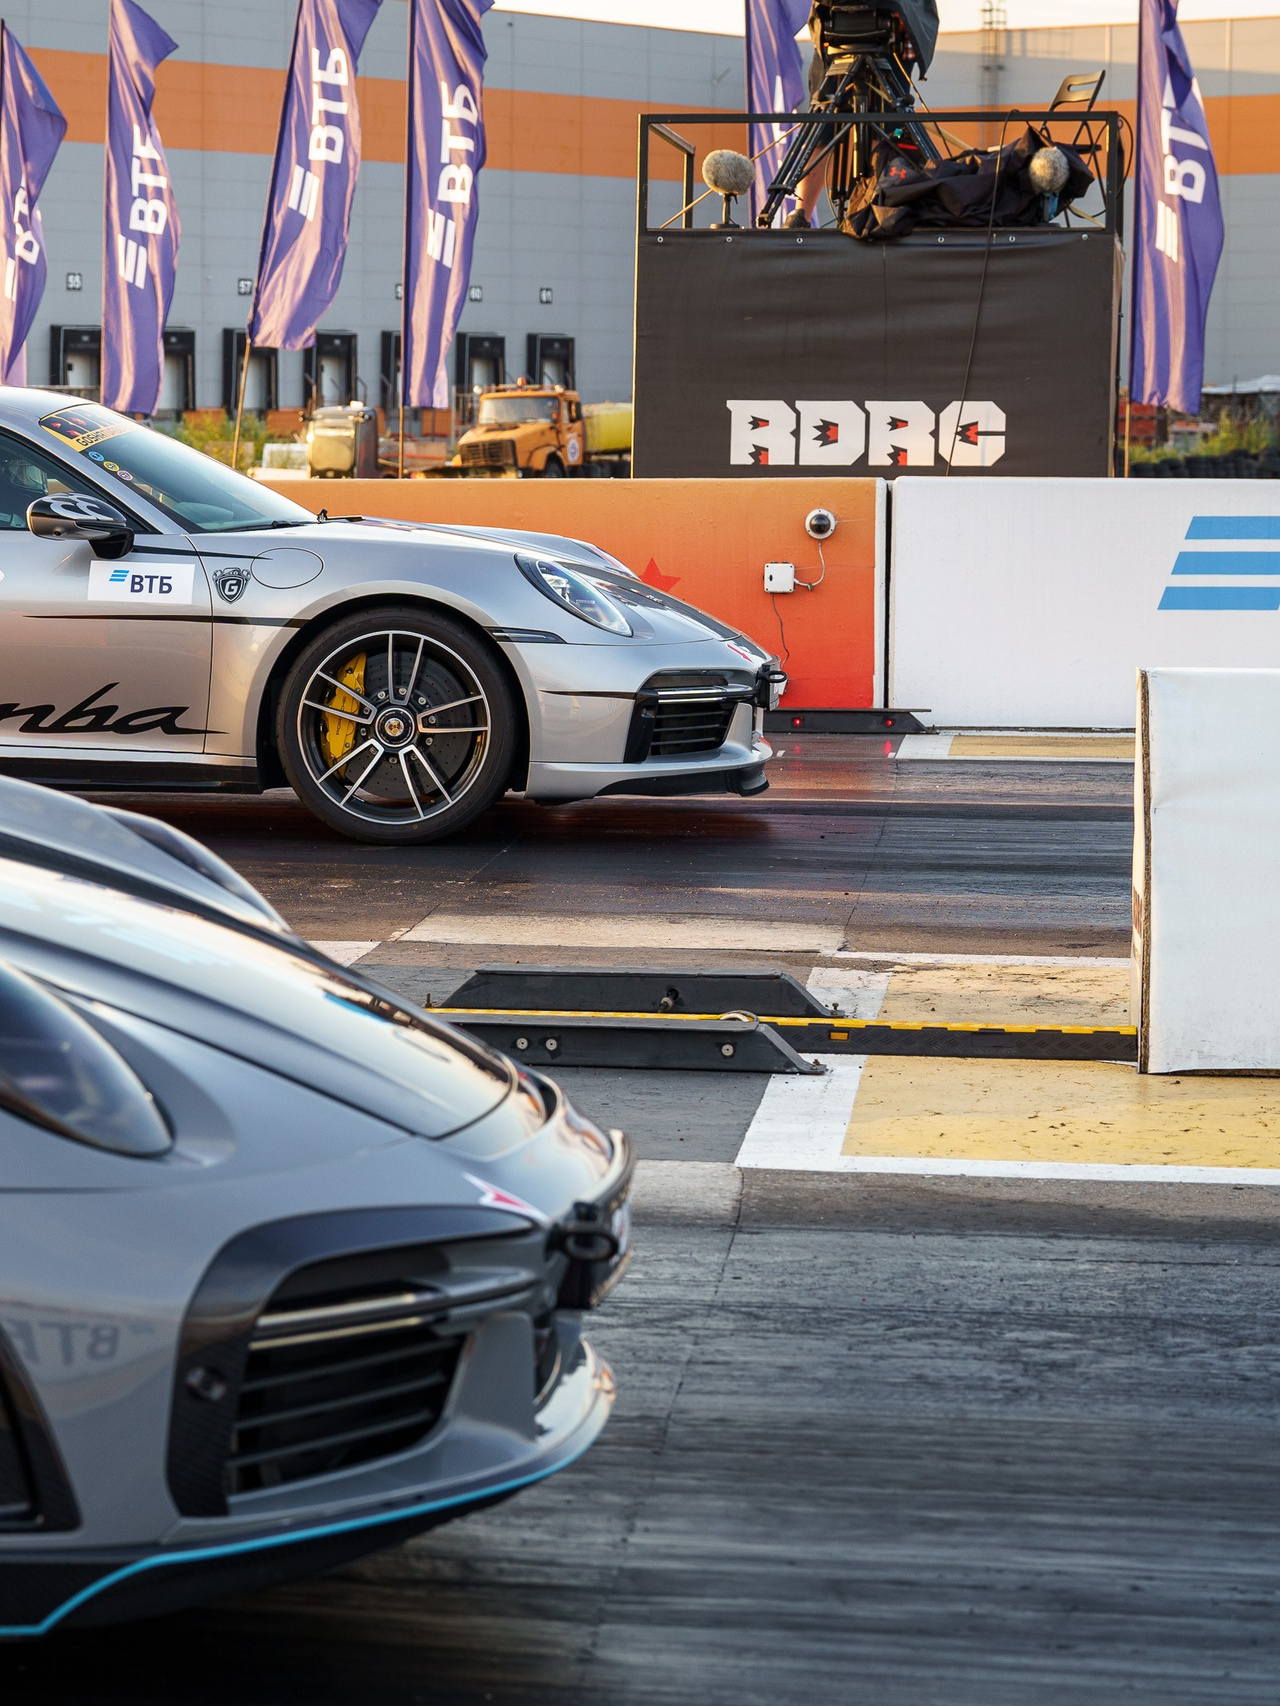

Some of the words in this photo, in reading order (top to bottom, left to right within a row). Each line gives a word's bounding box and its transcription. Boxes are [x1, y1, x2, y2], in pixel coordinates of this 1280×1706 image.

[308, 46, 349, 164] ВТБ
[437, 81, 479, 204] ВТБ
[1160, 74, 1209, 204] ВТ
[726, 400, 1006, 466] RDRC
[130, 574, 173, 594] ВТБ
